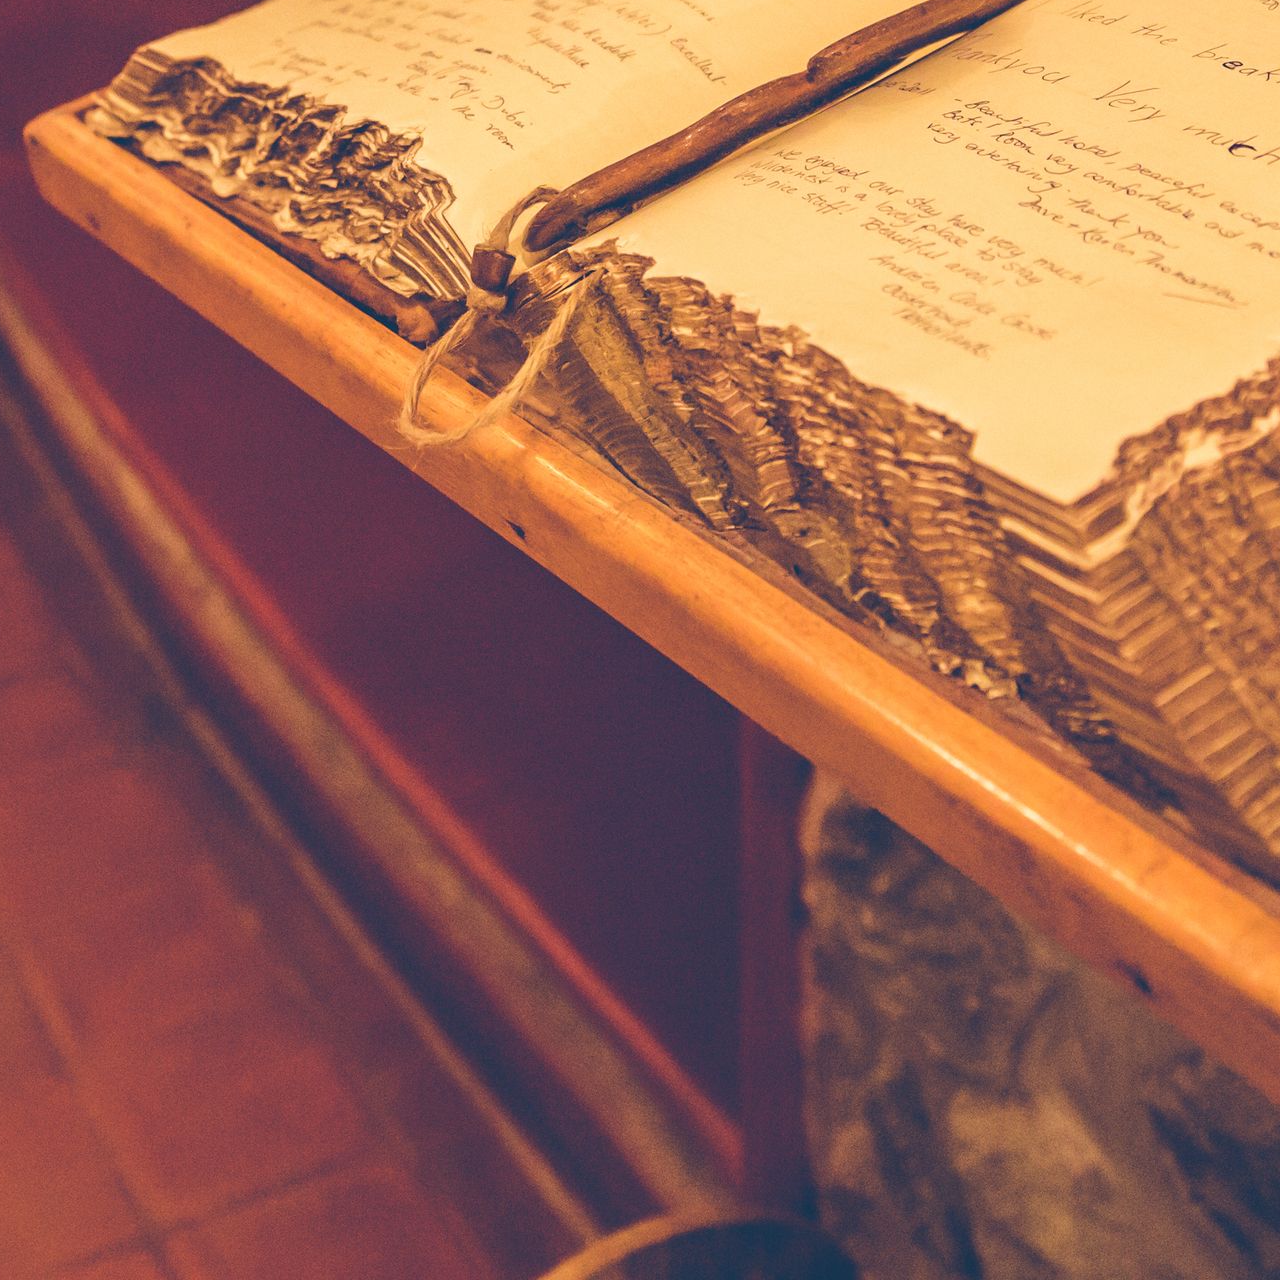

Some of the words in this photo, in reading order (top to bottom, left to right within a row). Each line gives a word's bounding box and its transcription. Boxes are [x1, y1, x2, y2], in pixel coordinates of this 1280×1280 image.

[1061, 0, 1129, 26] liked
[1130, 23, 1179, 47] the
[1094, 80, 1170, 124] Very
[854, 192, 867, 202] a
[868, 180, 905, 197] our
[905, 196, 943, 219] stay
